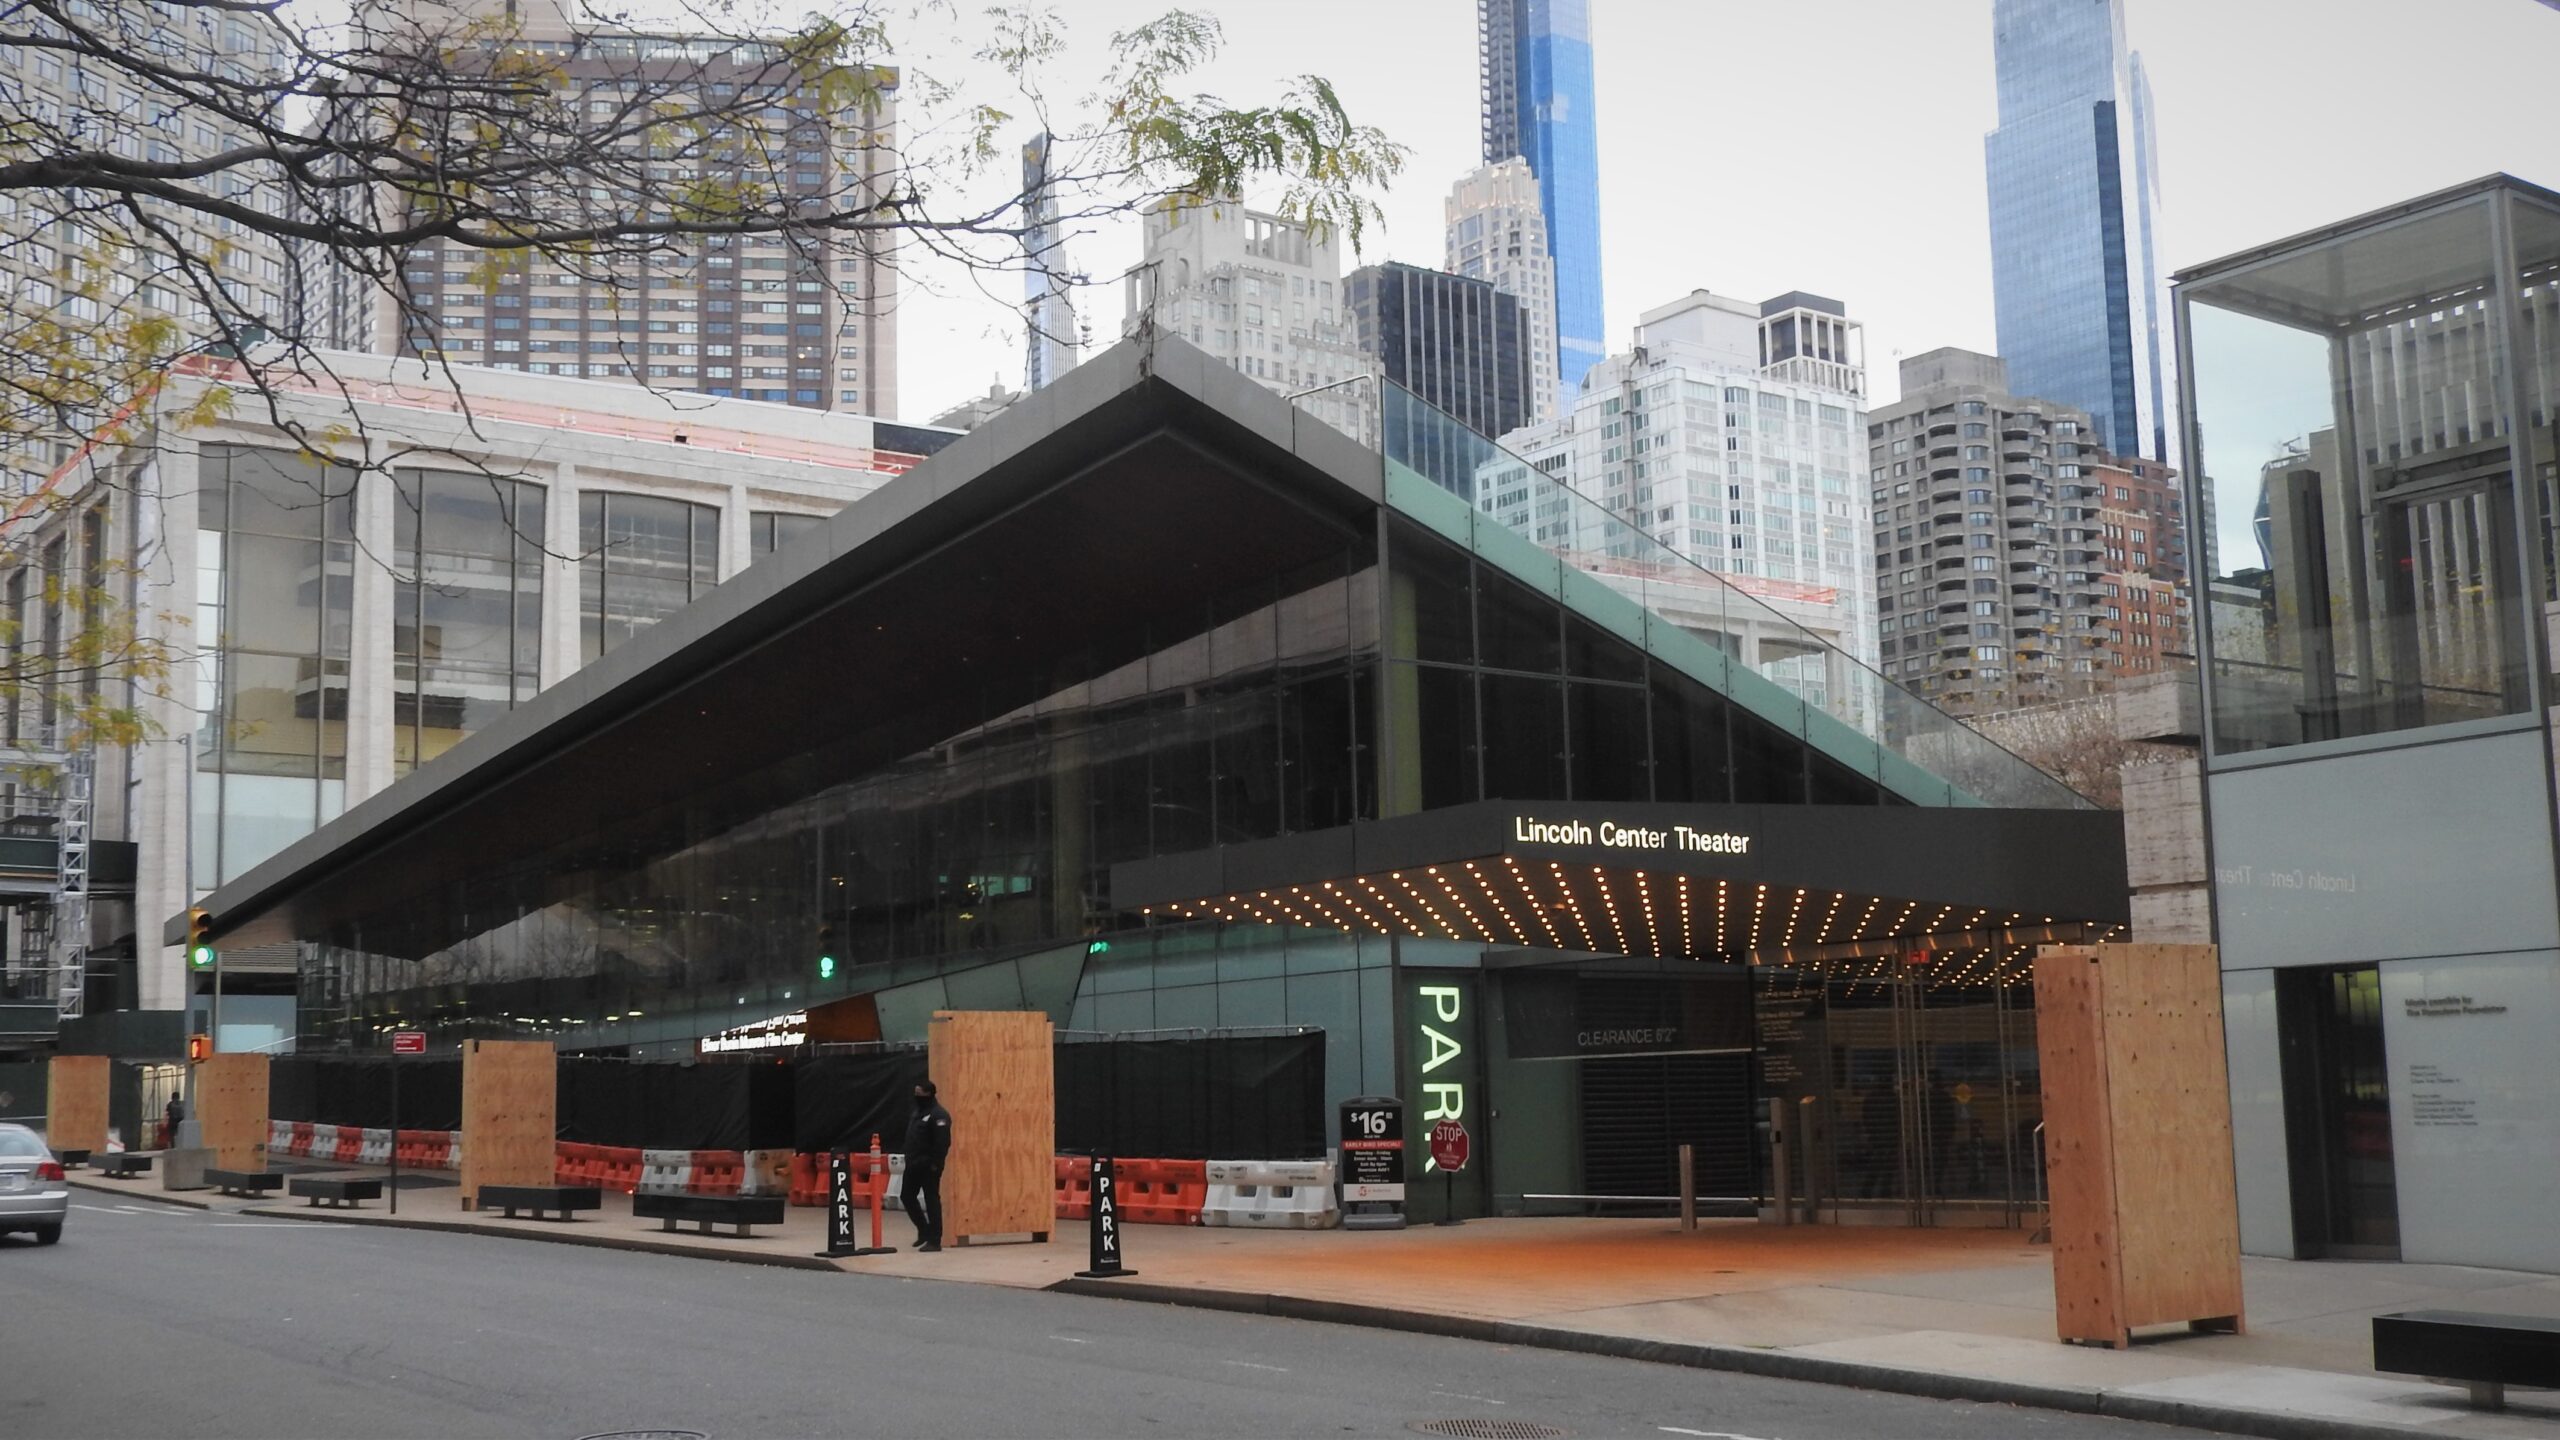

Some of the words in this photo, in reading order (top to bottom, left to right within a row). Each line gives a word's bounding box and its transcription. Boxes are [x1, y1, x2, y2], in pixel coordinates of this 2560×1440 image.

[1516, 816, 1592, 845] Lincoln
[1600, 821, 1667, 848] Center
[1674, 826, 1749, 853] Theater
[781, 1031, 805, 1046] Center
[1578, 1029, 1652, 1046] CLEARANCE
[1436, 1125, 1462, 1142] STOP
[837, 1171, 849, 1235] PARK
[1100, 1177, 1115, 1251] PARK
